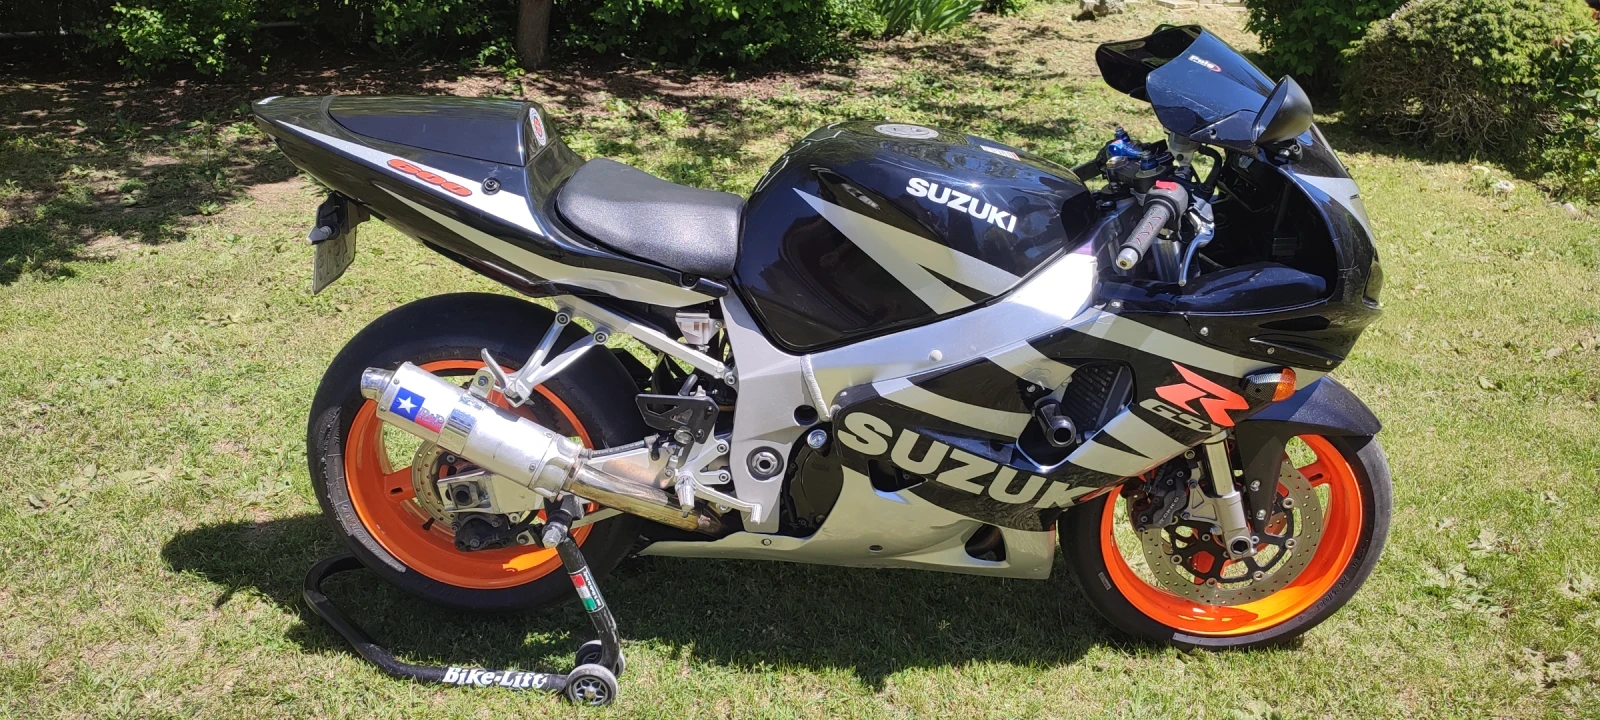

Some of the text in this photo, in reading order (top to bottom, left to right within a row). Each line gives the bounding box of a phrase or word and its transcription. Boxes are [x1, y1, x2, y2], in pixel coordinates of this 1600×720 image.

[387, 159, 472, 197] 600
[905, 177, 1018, 233] SUZUKI
[442, 667, 548, 689] Bike-Lift
